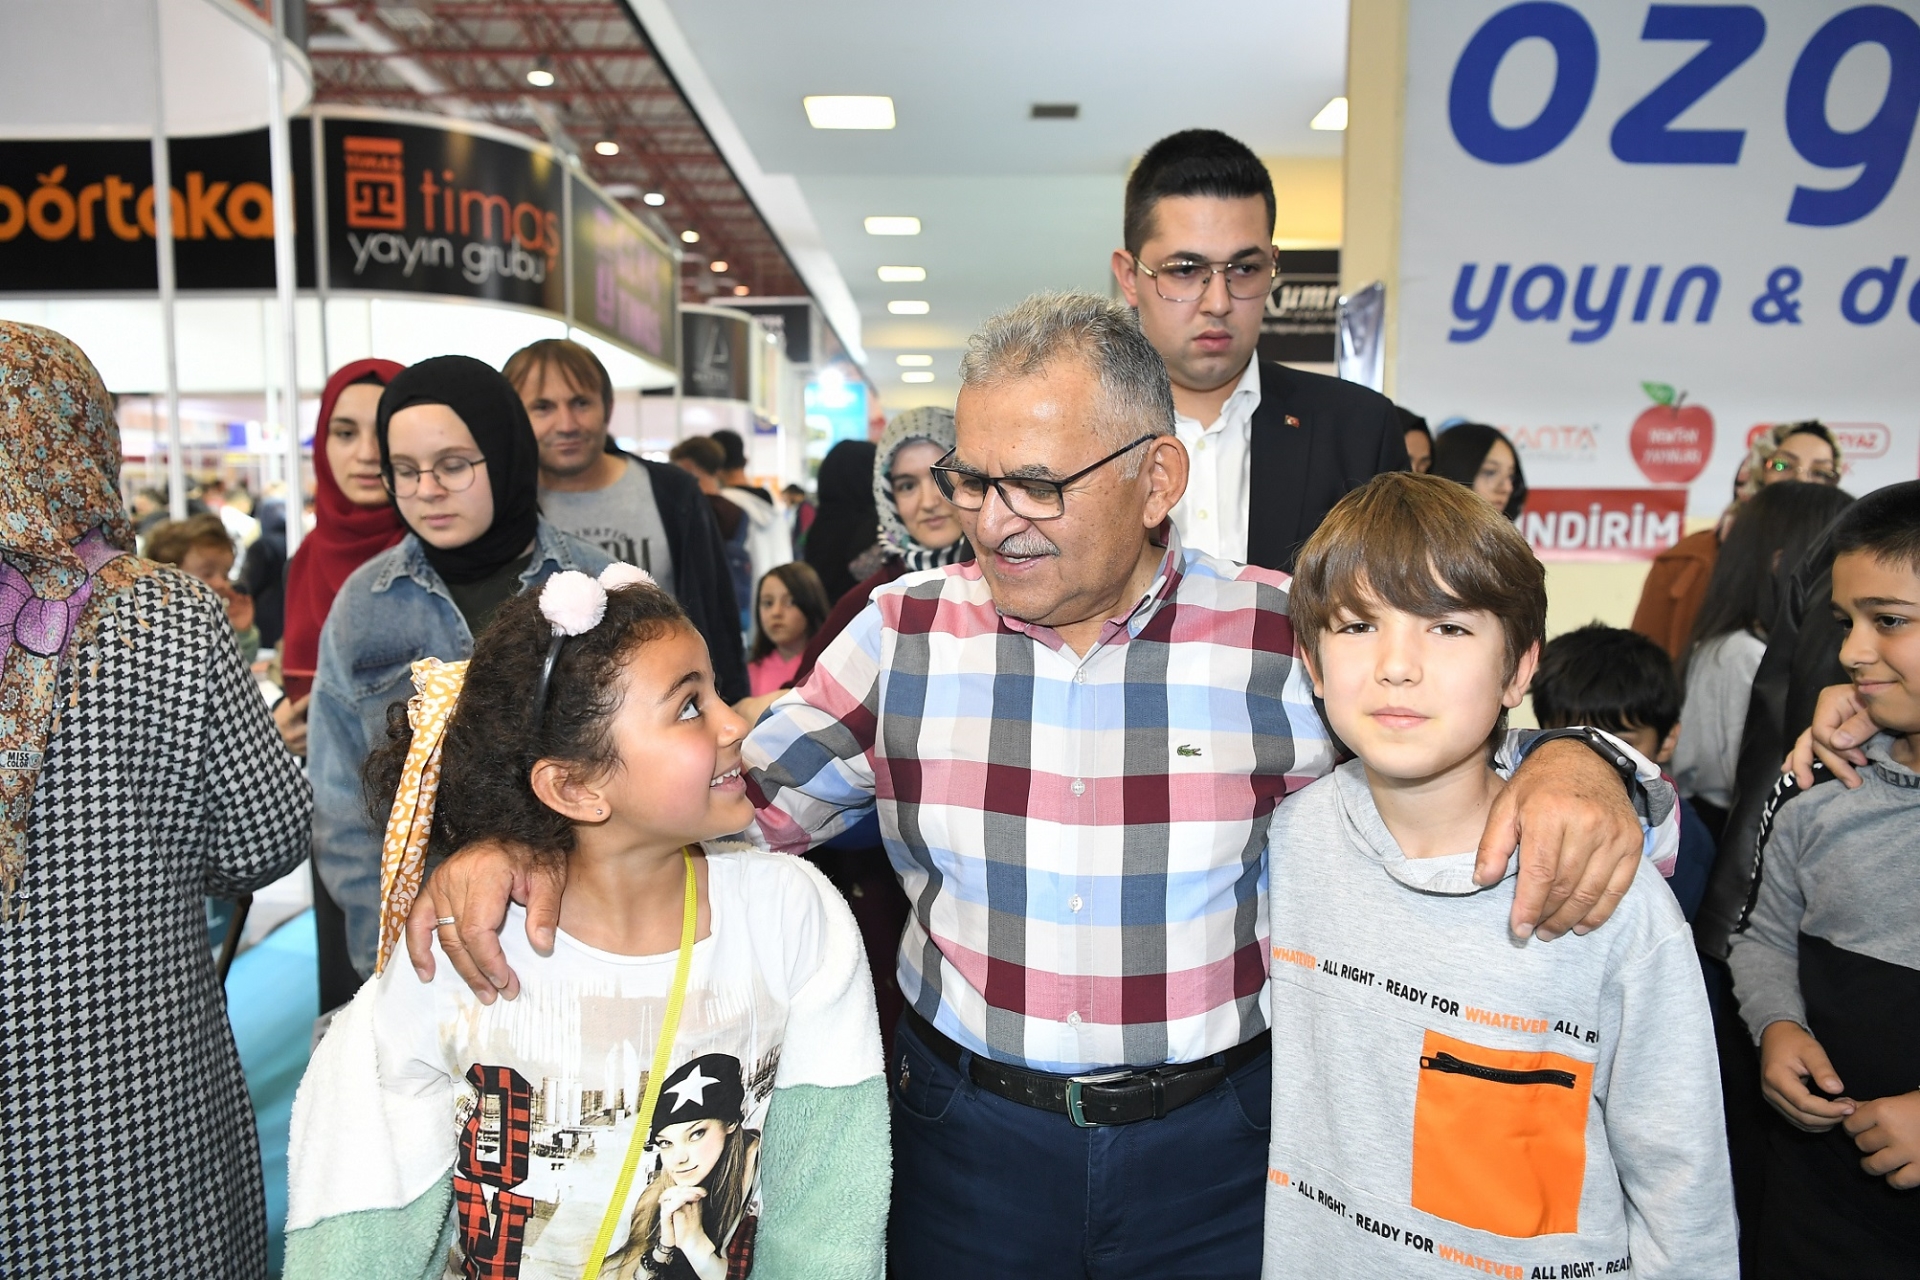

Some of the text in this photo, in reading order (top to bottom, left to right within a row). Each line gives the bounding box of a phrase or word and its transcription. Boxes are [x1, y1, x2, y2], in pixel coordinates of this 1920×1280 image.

[347, 232, 454, 277] yayın
[1447, 263, 1722, 344] yayın
[1751, 265, 1802, 325] &
[8, 752, 30, 761] MISS
[1271, 946, 1317, 970] WHATEVER
[1323, 959, 1338, 976] ALL
[1340, 964, 1375, 986] RIGHT
[1386, 978, 1428, 1004] READY
[1431, 995, 1460, 1017] FOR
[1464, 1005, 1549, 1034] WHATEVER
[1554, 1020, 1581, 1039] ALL
[1268, 1167, 1289, 1188] VER
[1298, 1180, 1315, 1200] ALL
[1318, 1189, 1347, 1217] RIGHT
[1356, 1212, 1400, 1242] READY
[1404, 1231, 1434, 1253] FOR
[1438, 1243, 1524, 1280] WHATEVER
[1531, 1266, 1557, 1280] ALL
[1561, 1261, 1595, 1279] RIGHT
